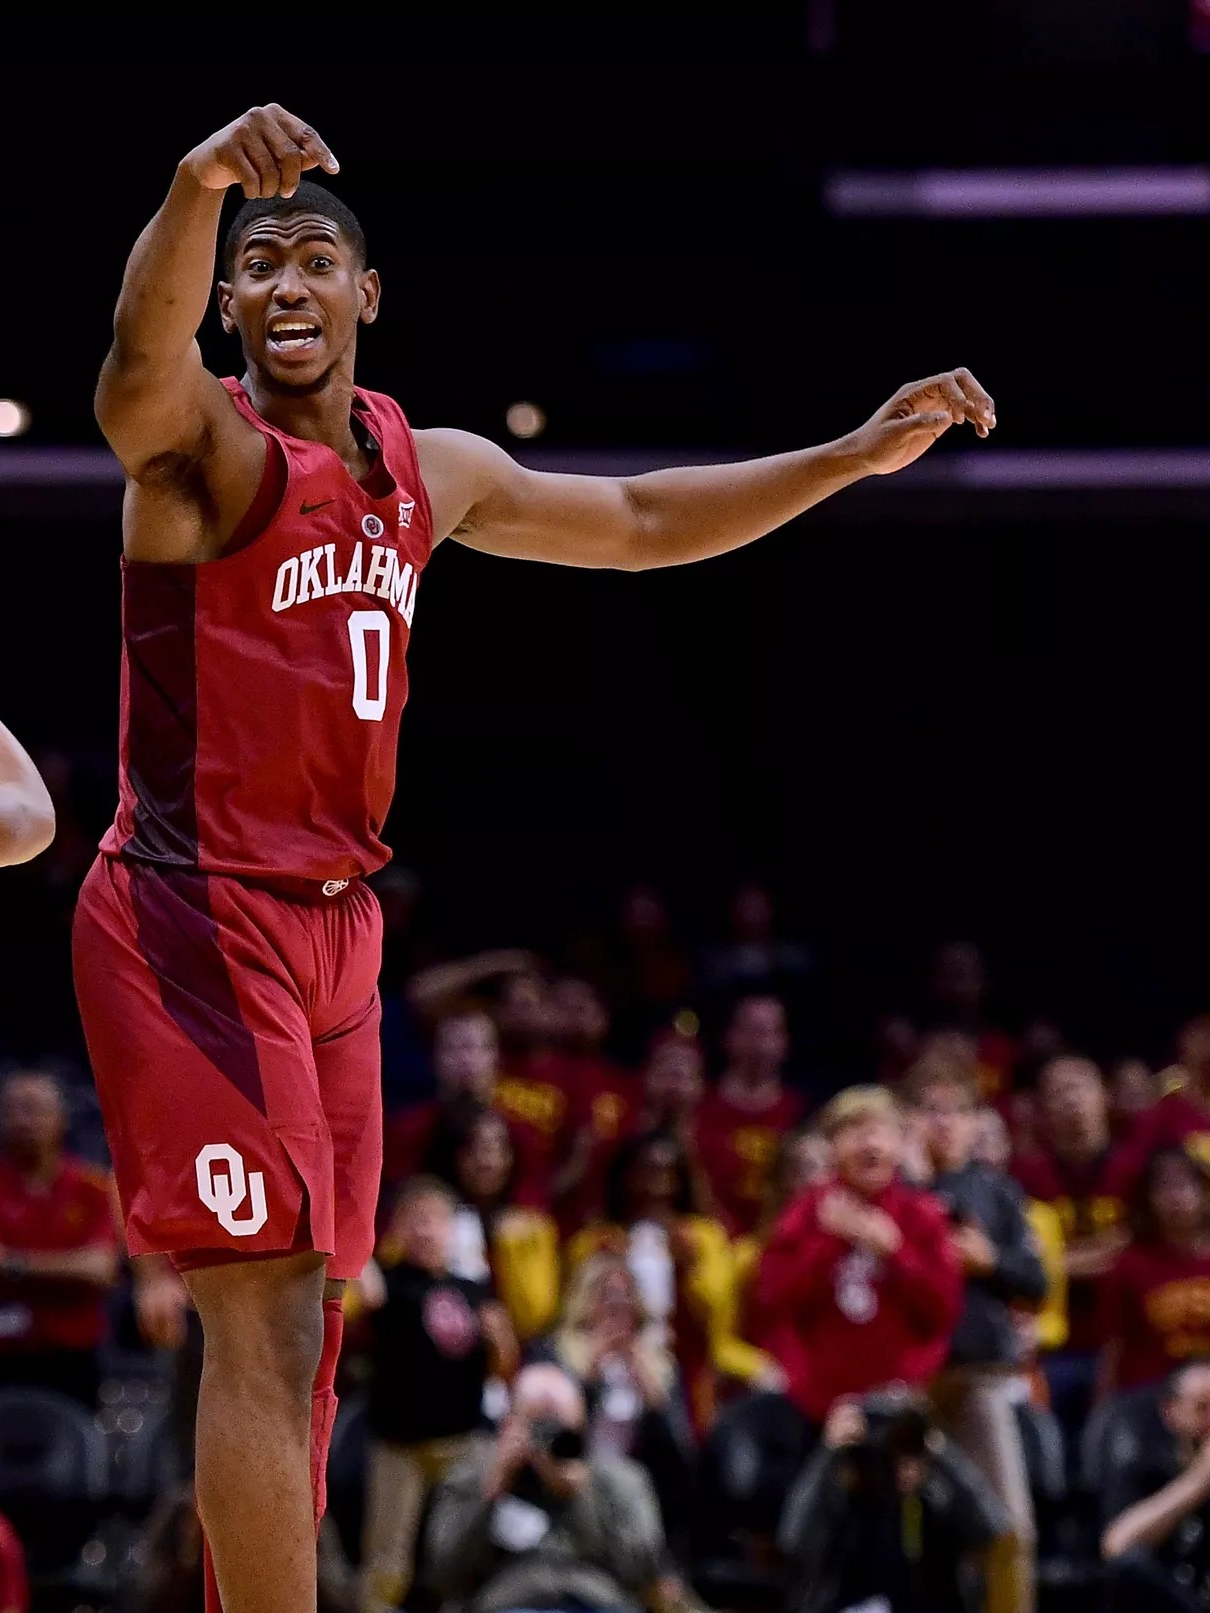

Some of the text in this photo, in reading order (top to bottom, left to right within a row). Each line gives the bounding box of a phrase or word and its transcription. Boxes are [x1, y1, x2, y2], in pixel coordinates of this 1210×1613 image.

[272, 541, 418, 629] OKLAHMA
[347, 610, 391, 721] 0
[195, 1143, 268, 1236] OU
